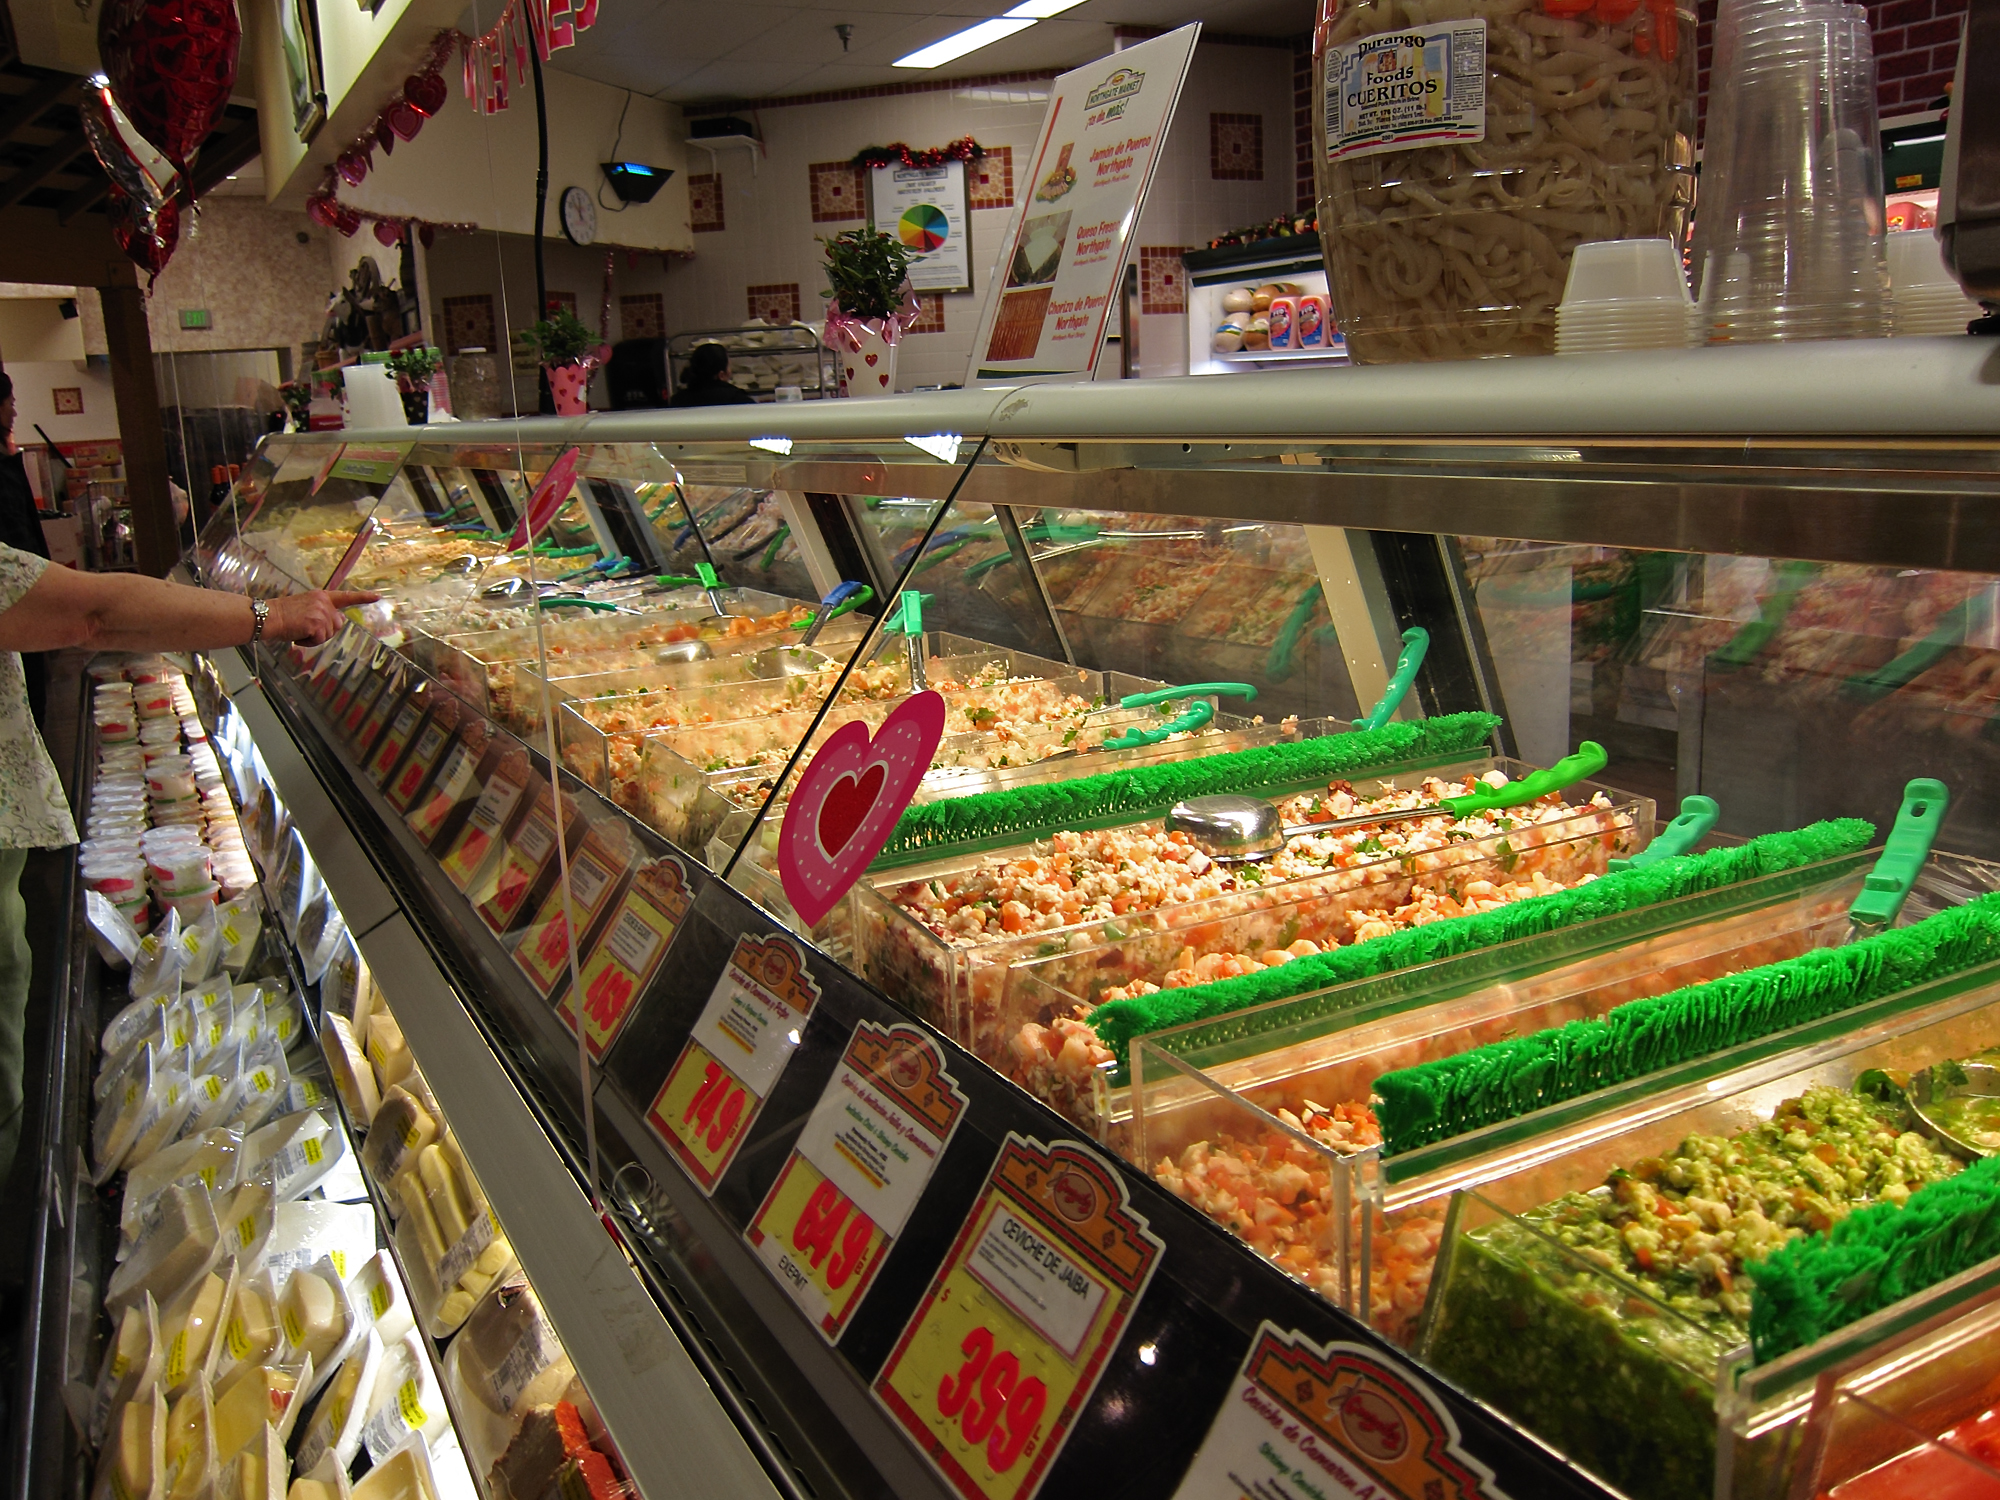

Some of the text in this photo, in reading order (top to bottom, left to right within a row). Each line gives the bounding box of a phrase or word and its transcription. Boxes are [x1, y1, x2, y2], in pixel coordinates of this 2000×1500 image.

[1358, 35, 1426, 61] Durango
[1367, 66, 1414, 86] Foods
[1090, 80, 1140, 104] NORTHGATE MARKET
[1347, 79, 1437, 108] CUERITOS
[1359, 111, 1368, 119] NET
[1115, 141, 1125, 156] de
[1125, 136, 1152, 153] Puerco
[1097, 155, 1134, 177] Northgate
[1076, 226, 1098, 240] Queso
[1076, 237, 1111, 256] Northgate
[1047, 299, 1074, 316] Chorizo
[1074, 297, 1083, 312] de
[186, 311, 205, 326] EXIT
[1055, 313, 1090, 331] Northgate
[1002, 1218, 1047, 1262] CEVICHE
[1043, 1251, 1062, 1275] DE
[1058, 1265, 1090, 1300] JAIBA
[778, 1254, 808, 1291] EXEPMT
[1241, 1386, 1284, 1430] Ceviche
[1281, 1424, 1300, 1444] de
[1298, 1435, 1358, 1490] Camaron
[1258, 1441, 1291, 1475] Shrimp
[1291, 1470, 1327, 1500] Cevich
